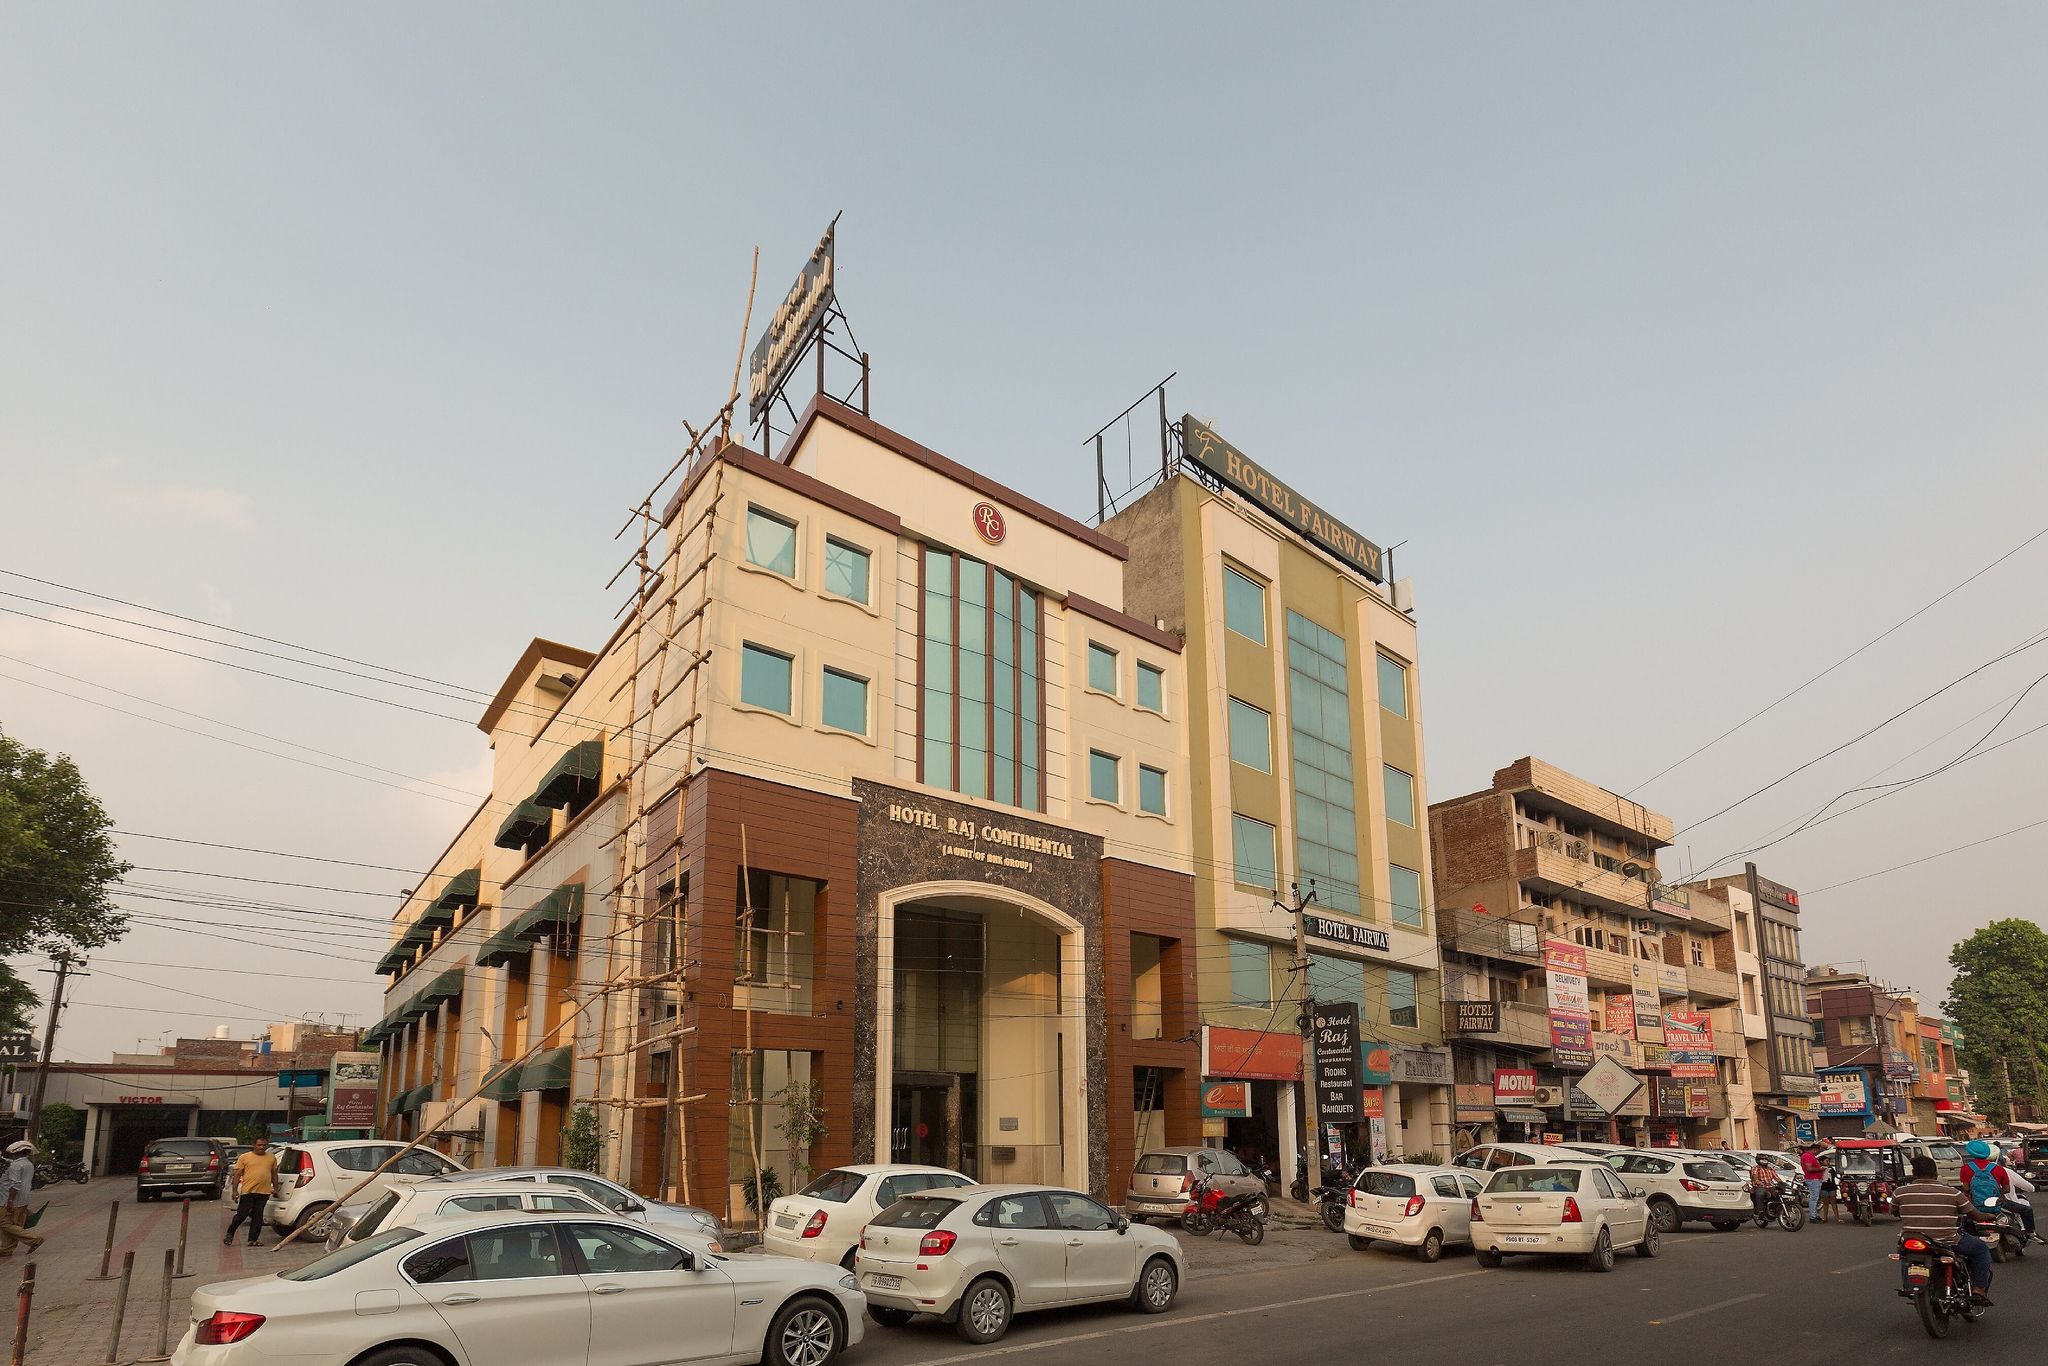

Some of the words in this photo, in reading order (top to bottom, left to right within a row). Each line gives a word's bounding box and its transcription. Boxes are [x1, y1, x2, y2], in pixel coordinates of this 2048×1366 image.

[1226, 450, 1295, 518] HOTEL
[1300, 502, 1379, 571] FAIRWAY
[889, 804, 941, 830] HOTEL
[947, 817, 976, 840] RAJ
[981, 825, 1075, 860] CONTINENTAL
[1318, 919, 1350, 940] HOTEL
[1459, 1004, 1494, 1016] HOTEL
[1327, 1015, 1351, 1027] Hotel
[1459, 1017, 1494, 1029] FAIRWAY
[1320, 1029, 1349, 1045] Raj
[1666, 1034, 1690, 1042] TRAVEL
[1691, 1034, 1709, 1042] VILLA
[1325, 1067, 1347, 1077] ROOMS
[1320, 1080, 1352, 1088] Restaurant
[1499, 1075, 1534, 1090] MOTUL
[1824, 1074, 1860, 1083] HATTI
[120, 1096, 162, 1104] VICTOR
[1330, 1092, 1343, 1101] BAR
[1322, 1104, 1354, 1113] BANQUETS
